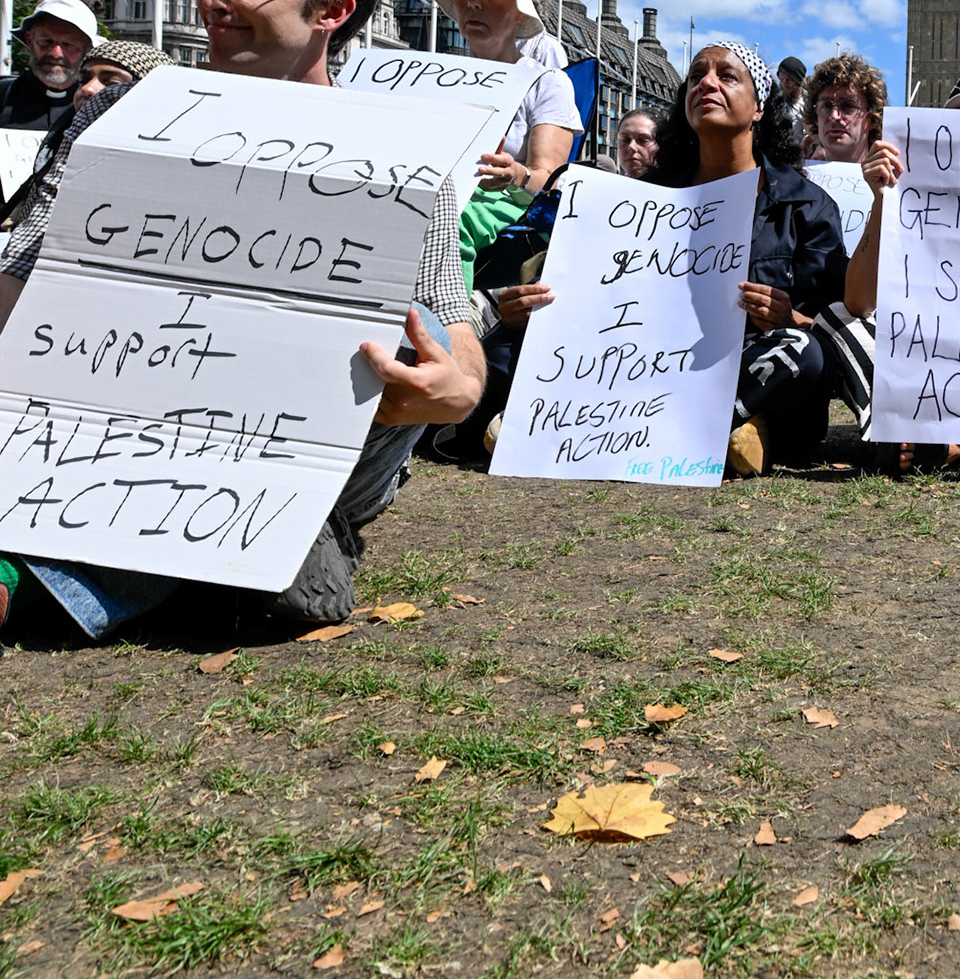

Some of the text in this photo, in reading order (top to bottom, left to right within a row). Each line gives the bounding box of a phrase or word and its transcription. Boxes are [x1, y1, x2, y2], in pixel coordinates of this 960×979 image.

[350, 57, 507, 91] I OPPOSE
[138, 89, 442, 220] I OPPOSE
[905, 118, 911, 174] I
[562, 179, 725, 241] I OPPOSE
[85, 203, 374, 284] GENOCIDE
[904, 254, 909, 299] I
[159, 291, 212, 329] I
[598, 301, 644, 335] I
[536, 342, 692, 390] SUPPORT
[0, 397, 307, 467] PALESTINE
[555, 425, 651, 464] ACTION.
[0, 476, 298, 551] ACTION
